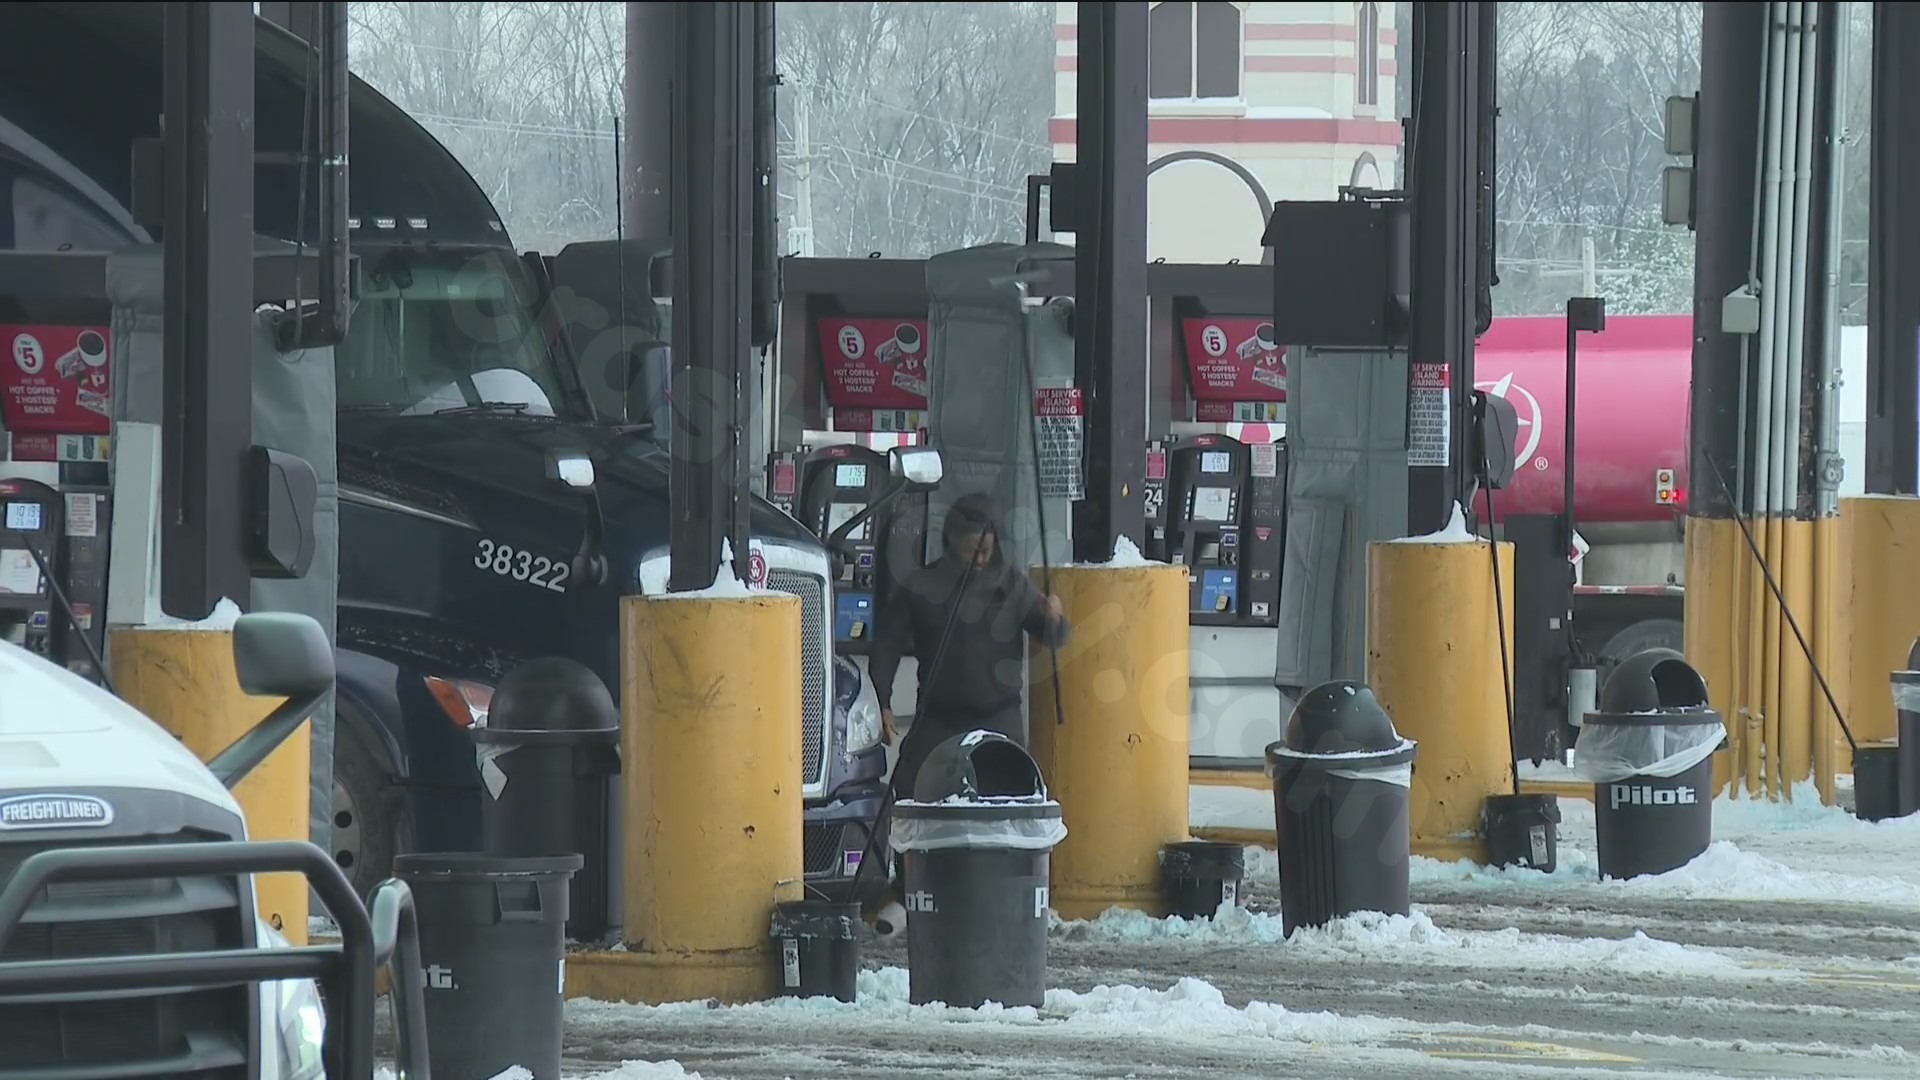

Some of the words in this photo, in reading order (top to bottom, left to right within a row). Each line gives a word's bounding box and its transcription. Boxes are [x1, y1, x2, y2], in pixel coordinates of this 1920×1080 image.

[1421, 363, 1449, 372] SERVICE
[1414, 371, 1440, 379] ISLAND
[9, 385, 25, 394] HOT
[26, 386, 56, 394] COFFEE
[845, 385, 873, 393] SNACKS
[1051, 389, 1082, 398] SERVICE
[1044, 398, 1070, 406] ISLAND
[24, 405, 56, 414] SNACKS
[1040, 405, 1077, 415] WARNING
[1144, 489, 1163, 506] 24
[474, 538, 570, 593] 38322
[2, 800, 103, 820] FREIGHTLINER
